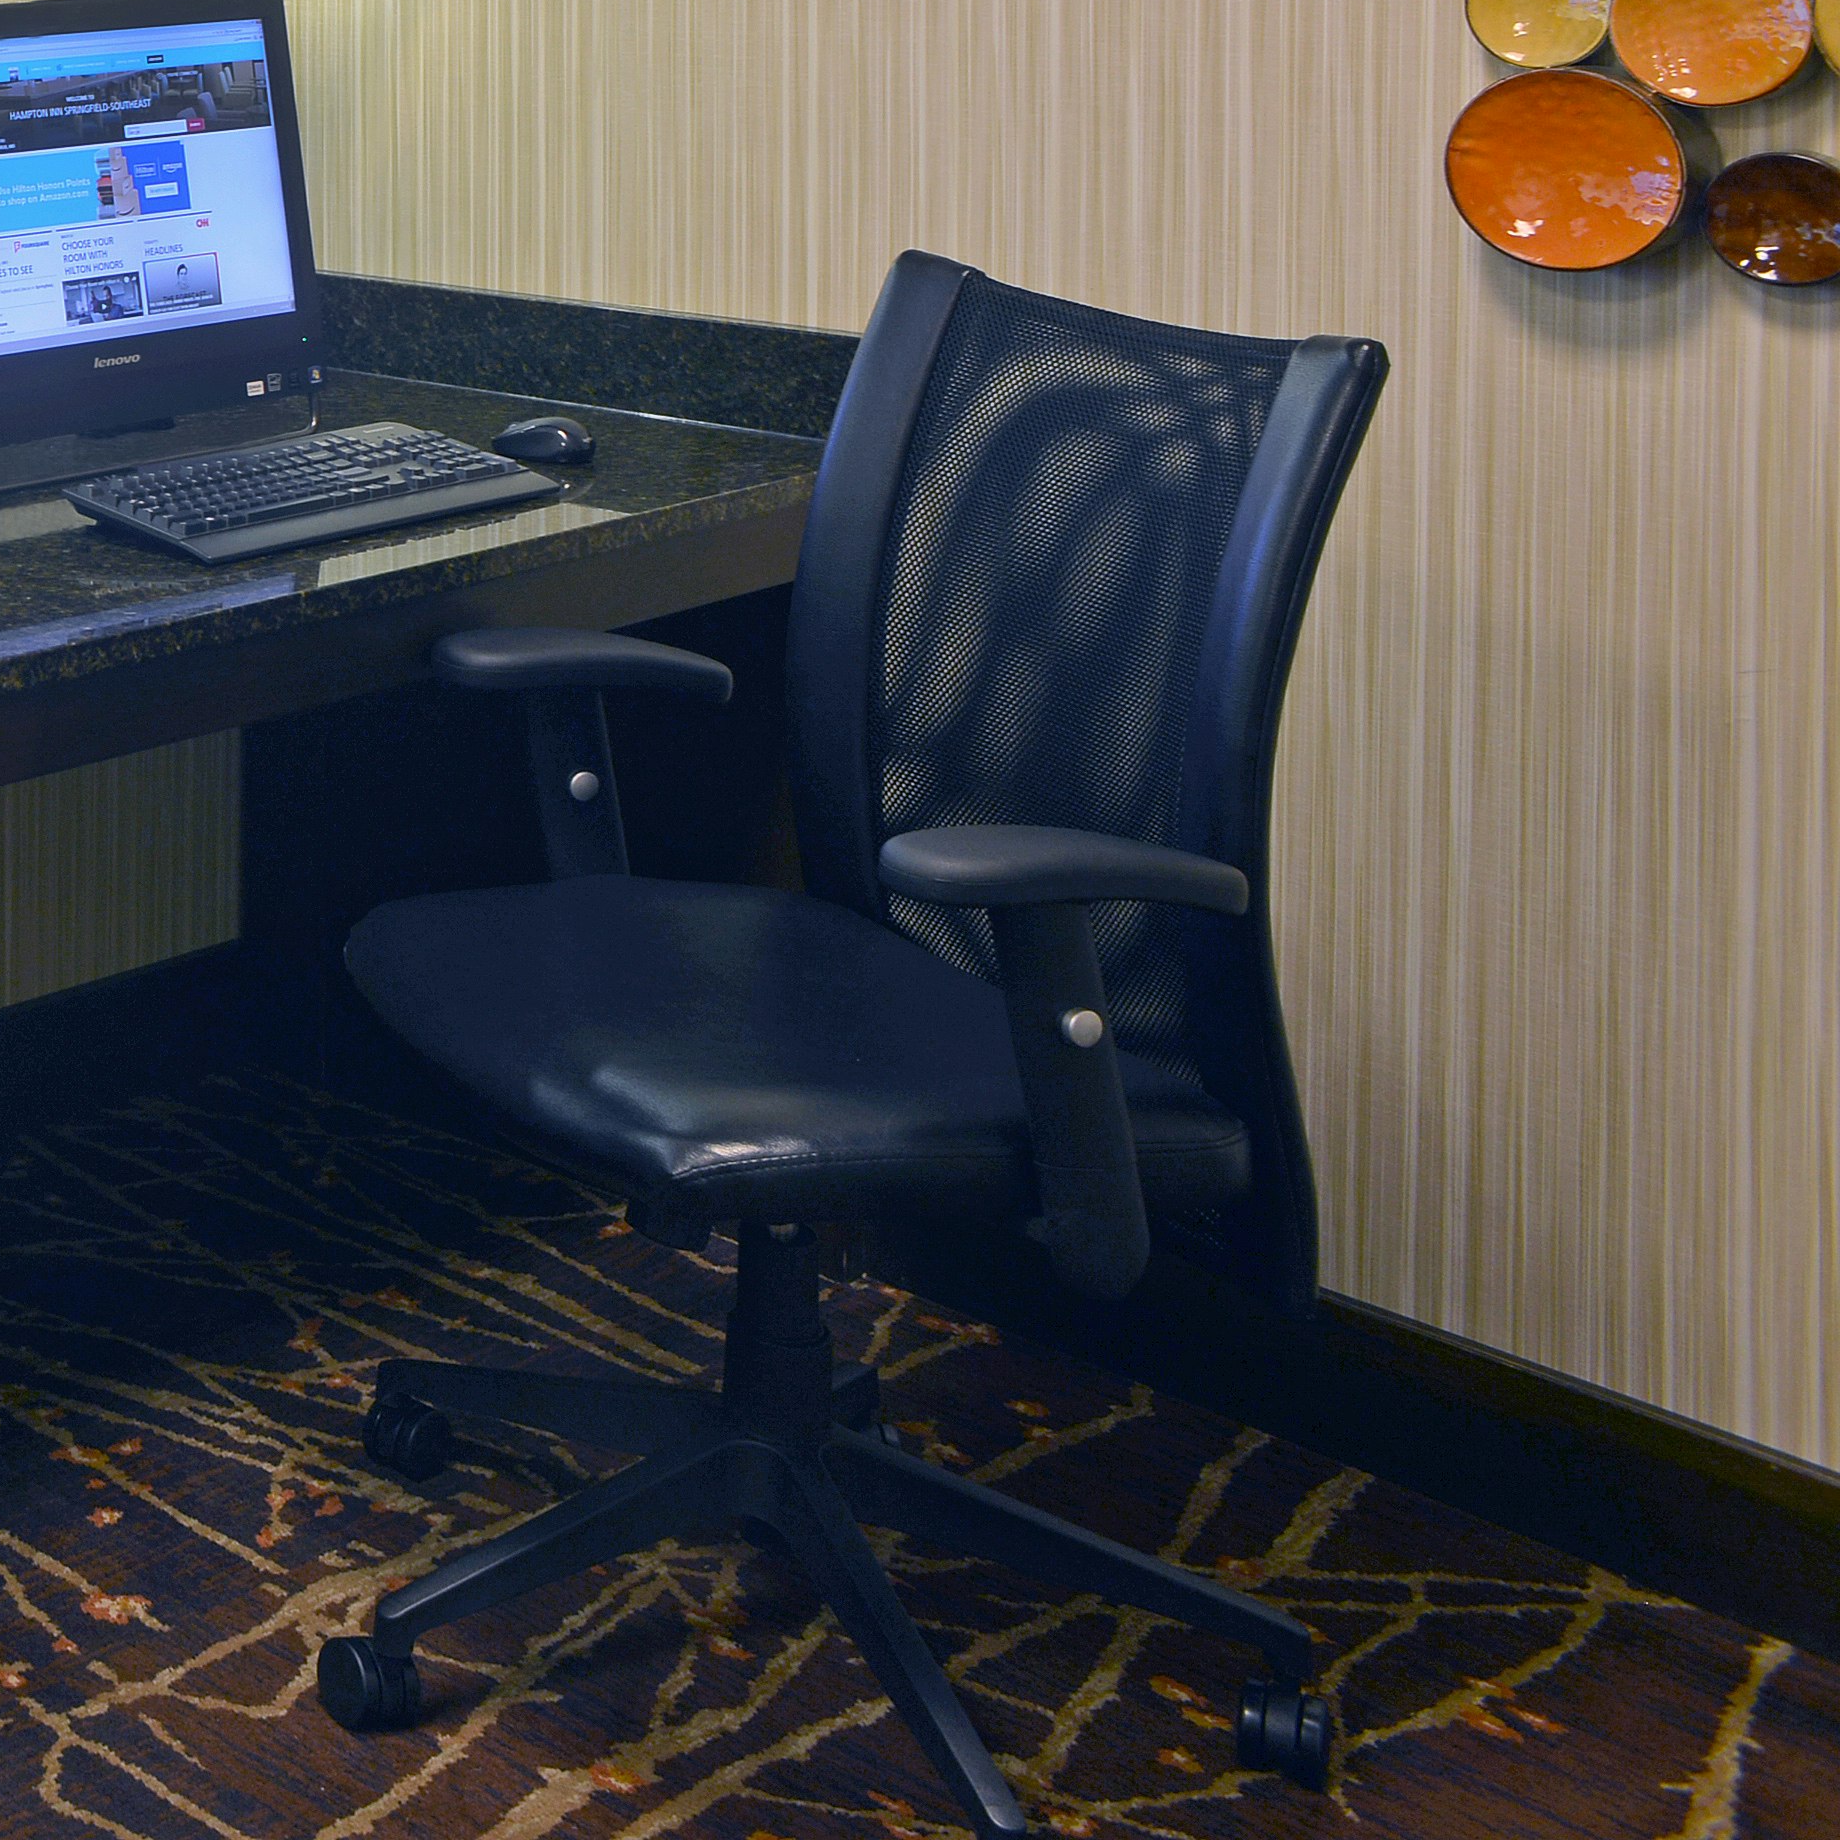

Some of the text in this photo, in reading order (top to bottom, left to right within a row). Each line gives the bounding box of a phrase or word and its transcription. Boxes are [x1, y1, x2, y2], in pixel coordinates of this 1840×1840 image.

[10, 98, 152, 121] HAMPTON INN SPRINGFIELD-SOUTHEAST
[12, 184, 36, 193] Hilton
[37, 182, 64, 190] Honors
[66, 178, 90, 187] Points
[8, 198, 26, 206] shop
[40, 190, 88, 202] Amazon.com
[62, 237, 114, 251] CHOOSE YOUR
[145, 244, 183, 256] HEADLINES
[63, 250, 108, 262] ROOM WITH
[8, 267, 19, 276] TO
[20, 265, 33, 274] SEE
[65, 260, 124, 275] HILTON HONORS
[94, 354, 141, 368] lenovo
